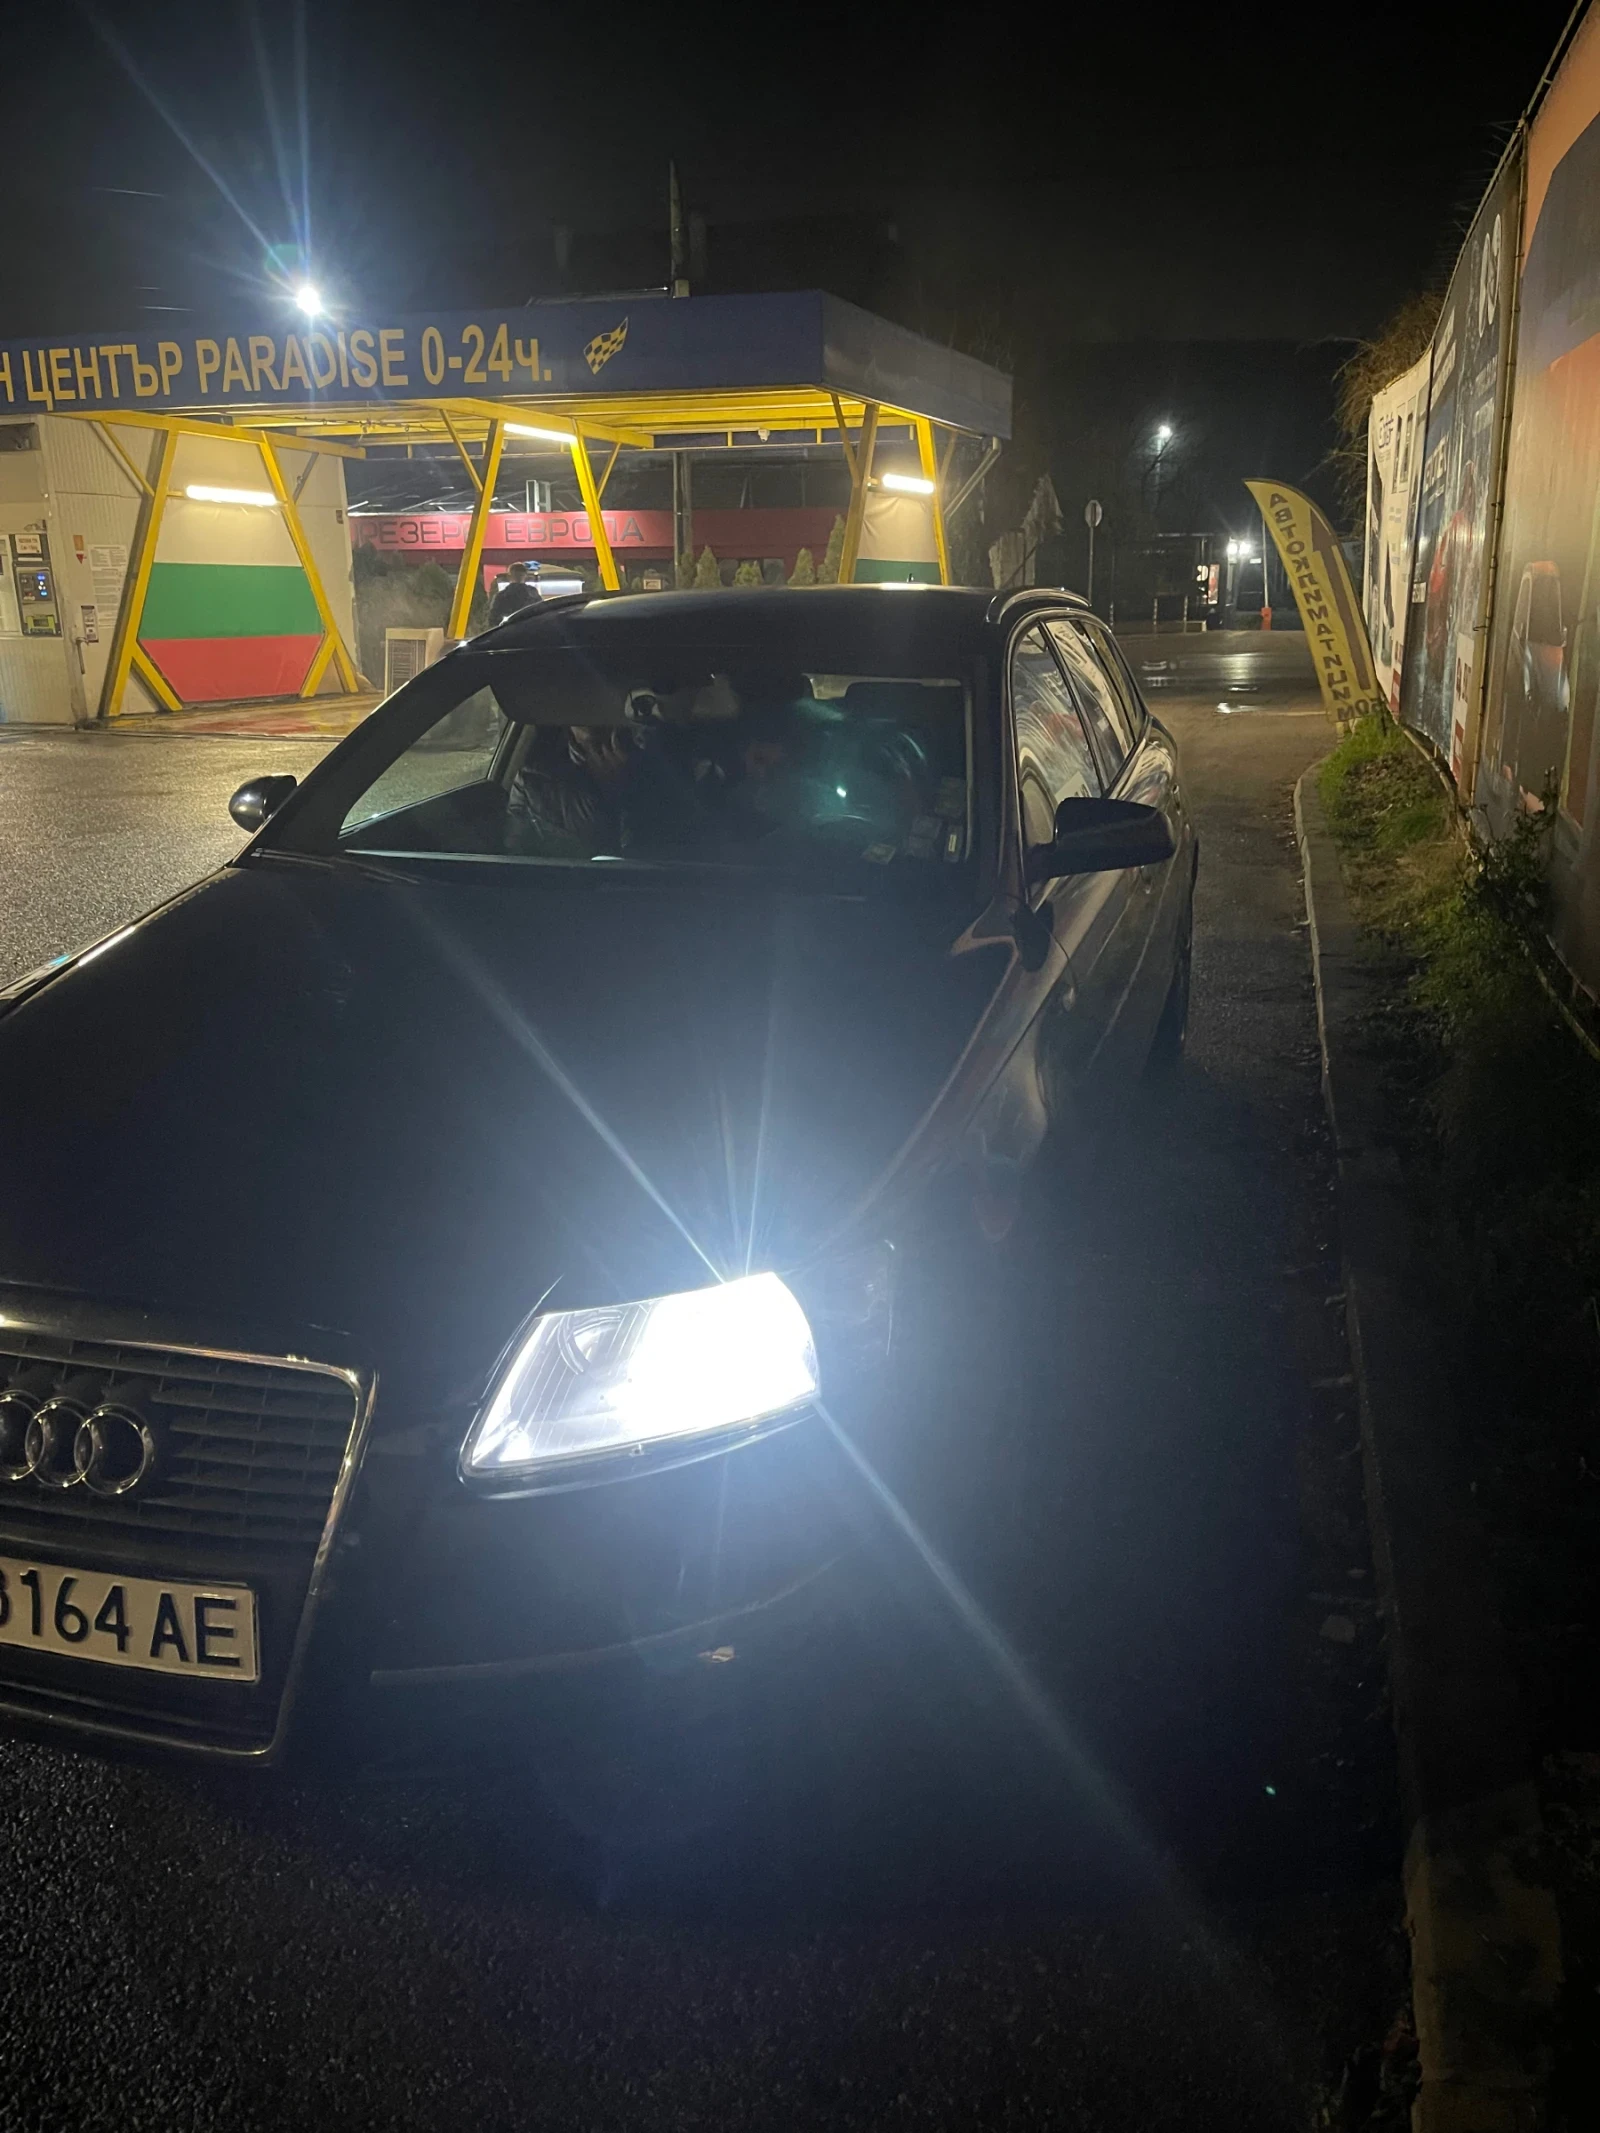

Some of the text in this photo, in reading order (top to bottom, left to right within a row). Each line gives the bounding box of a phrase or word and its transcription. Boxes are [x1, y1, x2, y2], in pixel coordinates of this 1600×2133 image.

[23, 342, 183, 411] ЦЕНТЪР
[195, 329, 409, 394] PARADISE
[421, 323, 552, 385] 0-24ч.
[505, 517, 645, 543] ЕВРОПА
[150, 1592, 241, 1667] AE
